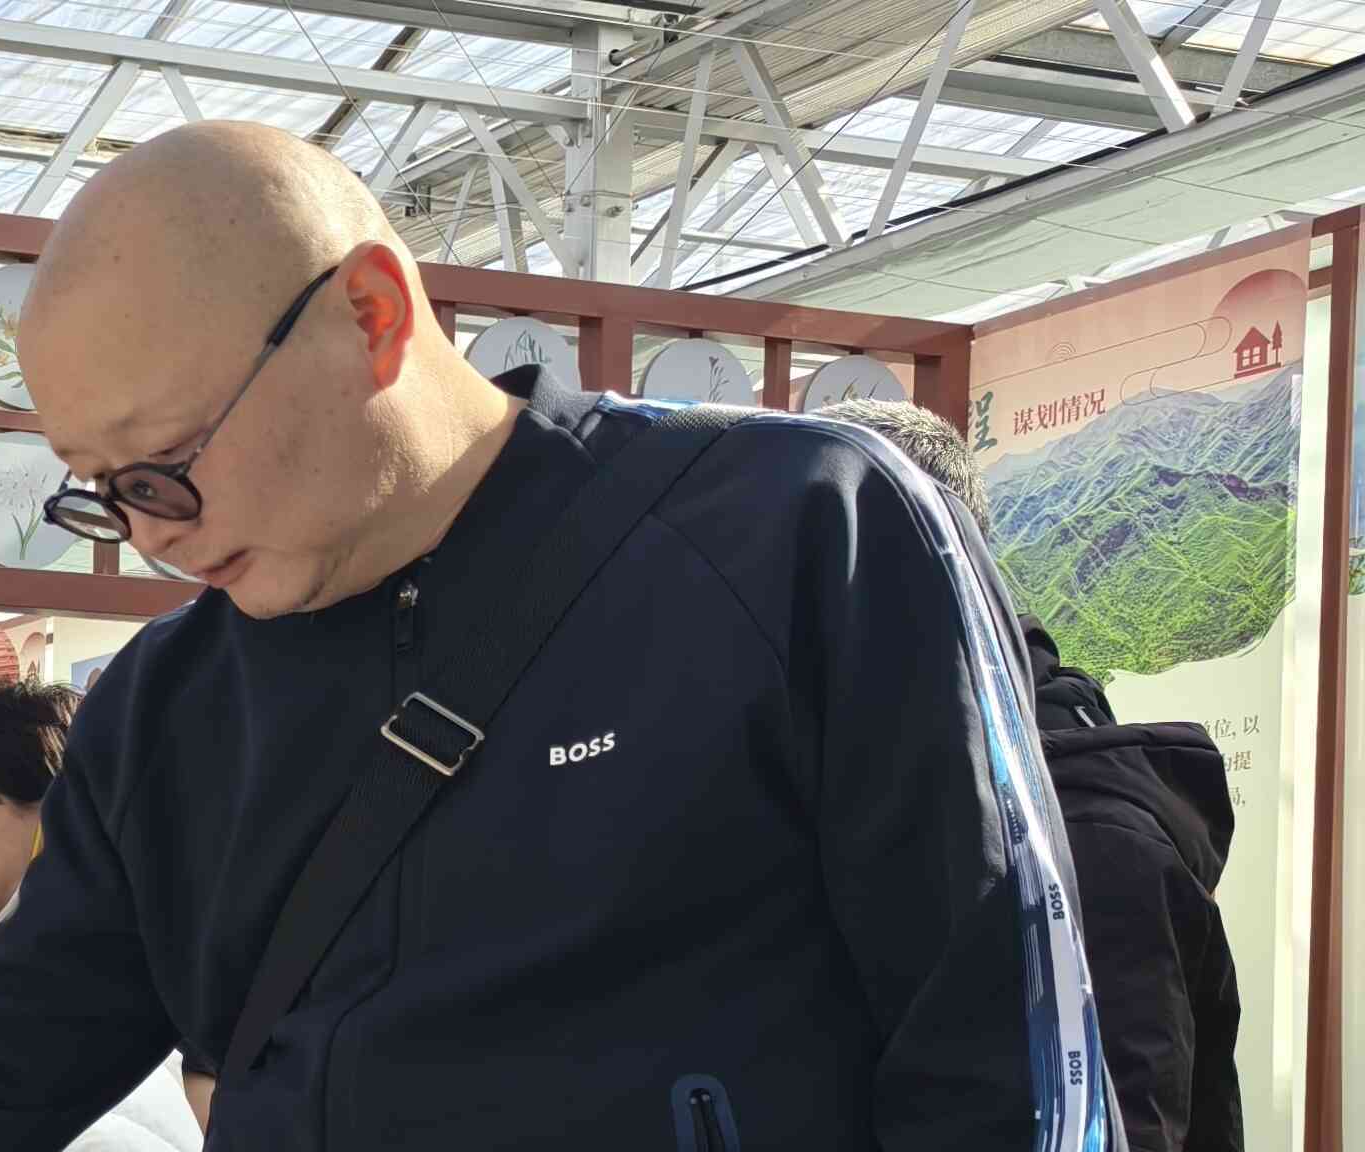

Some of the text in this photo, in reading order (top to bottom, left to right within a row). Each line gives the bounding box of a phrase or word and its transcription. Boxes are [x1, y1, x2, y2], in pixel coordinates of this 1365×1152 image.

[1013, 388, 1106, 436] 谋划情况
[549, 732, 616, 766] BOSS
[1048, 882, 1066, 920] BOSS
[1068, 1050, 1083, 1087] BOSS
